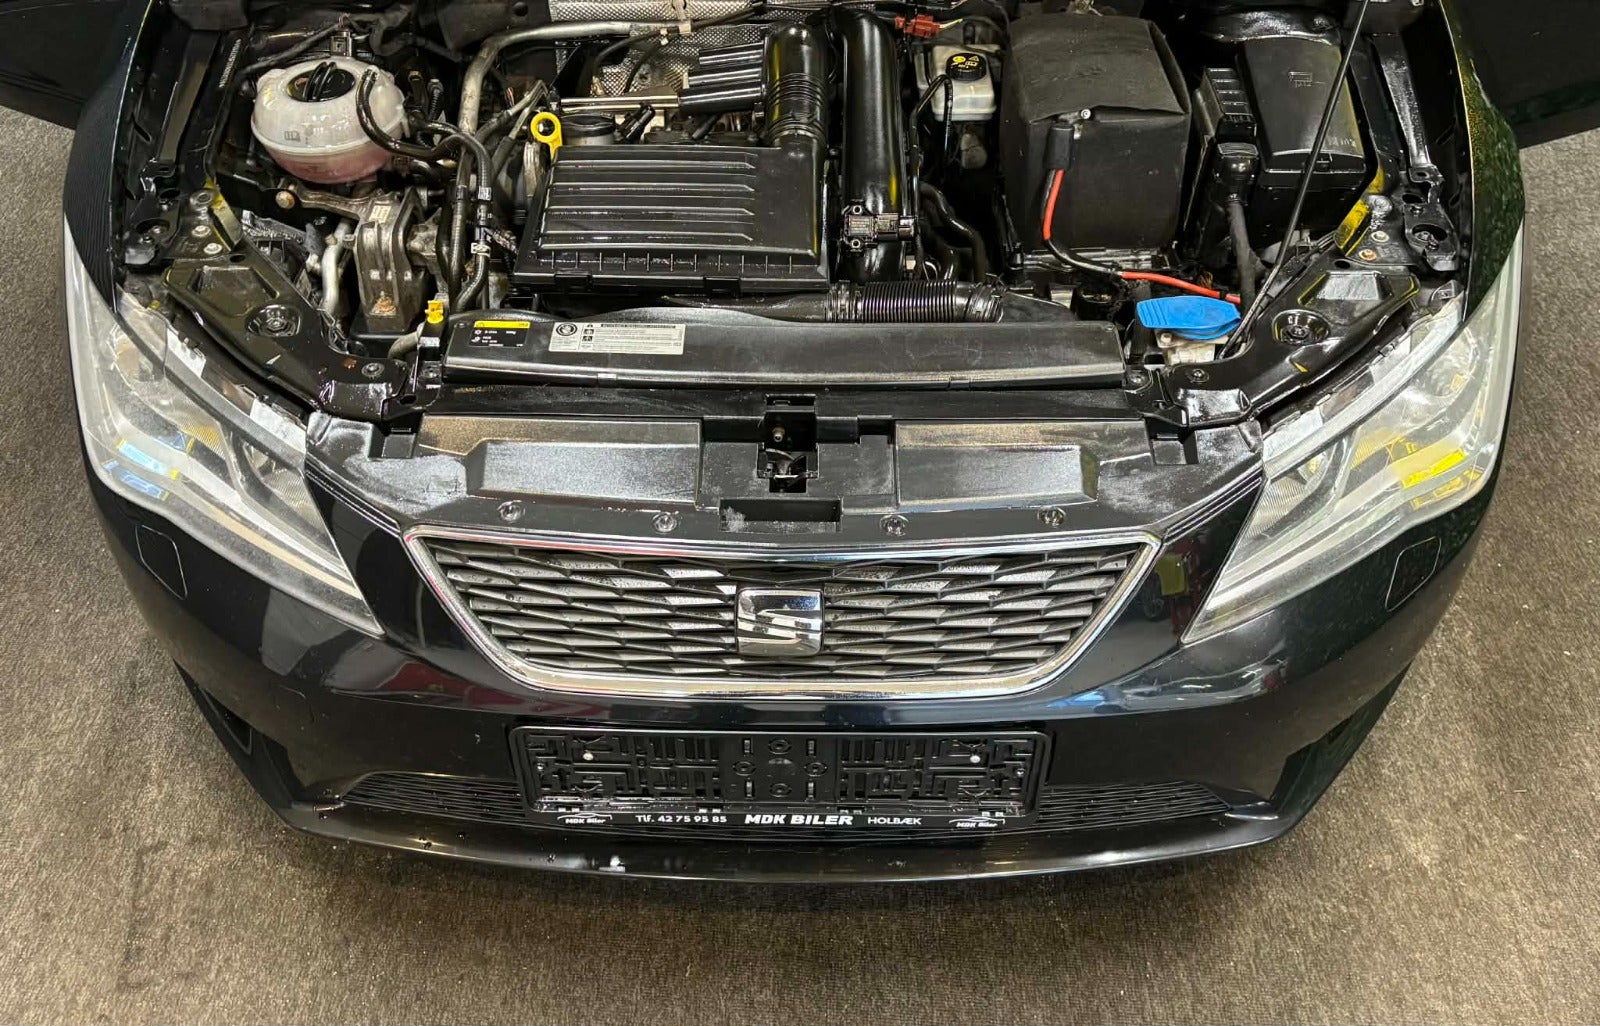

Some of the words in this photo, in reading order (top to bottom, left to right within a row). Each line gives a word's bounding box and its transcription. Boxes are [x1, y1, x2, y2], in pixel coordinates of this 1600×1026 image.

[635, 814, 655, 823] Tlf.
[657, 815, 673, 823] 42
[675, 815, 691, 823] 75
[694, 815, 709, 823] 95
[712, 815, 727, 823] 85
[744, 814, 786, 825] MDK
[790, 815, 853, 825] BILER
[867, 816, 922, 825] HOLBÆK
